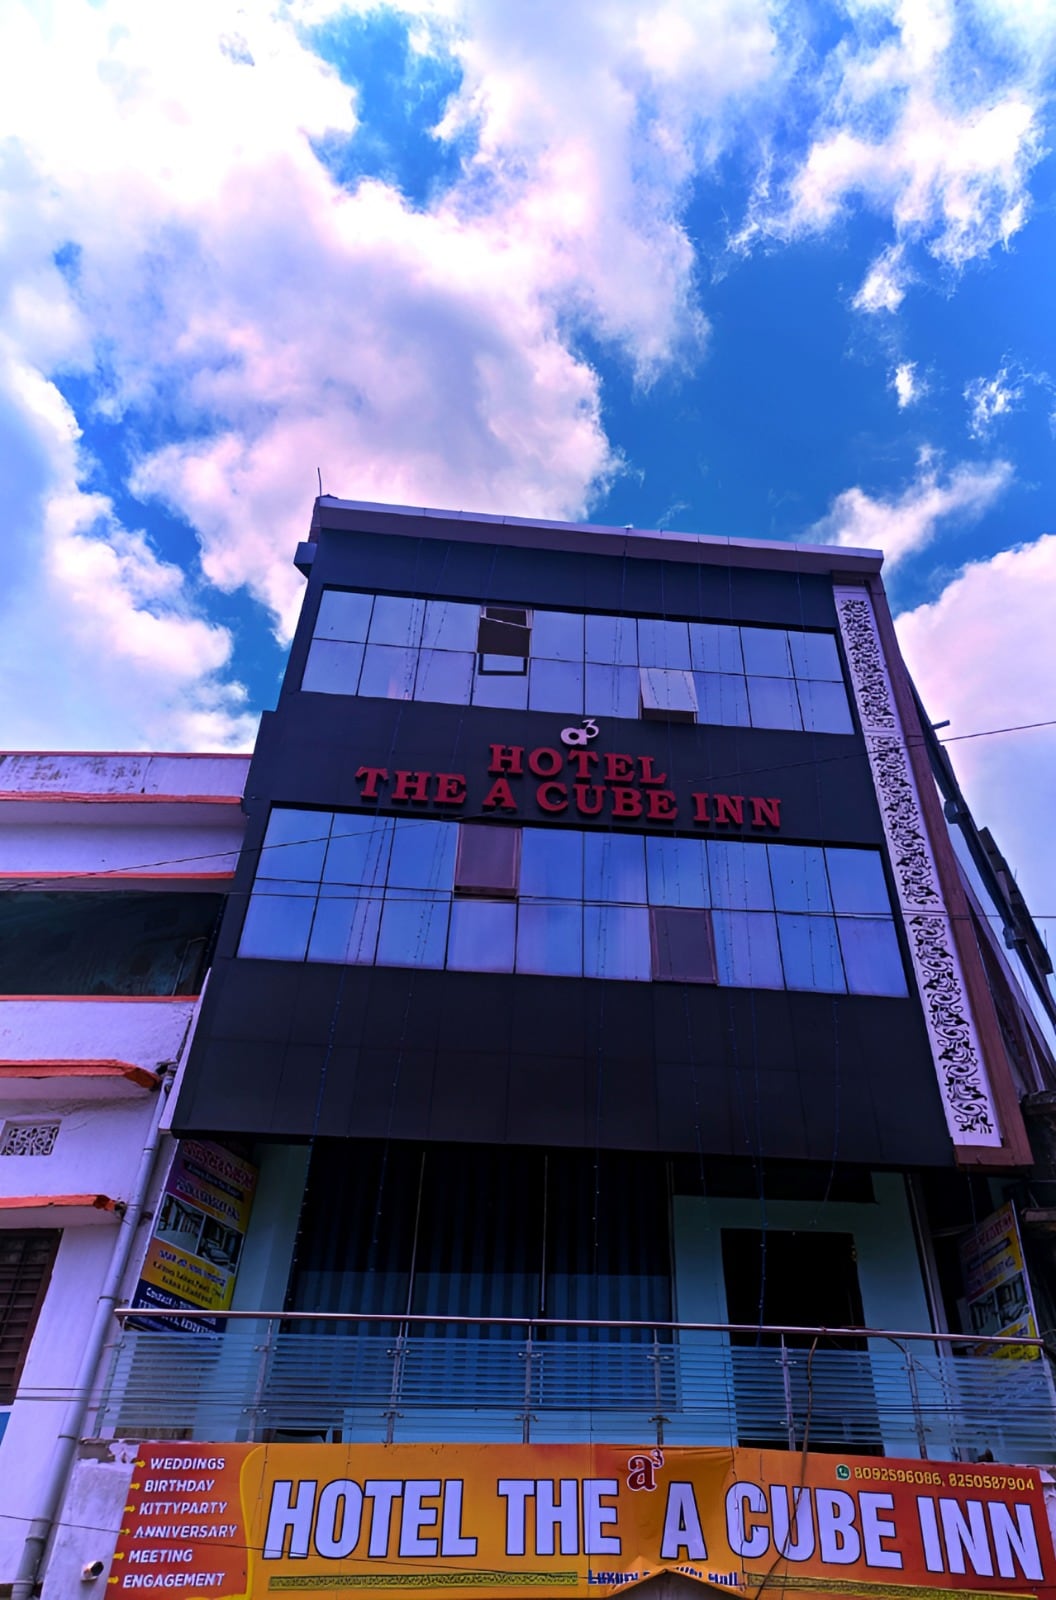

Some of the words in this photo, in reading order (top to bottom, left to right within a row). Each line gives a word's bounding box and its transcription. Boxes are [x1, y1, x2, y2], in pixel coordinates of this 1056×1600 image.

[488, 744, 667, 785] HOTEL
[355, 766, 467, 805] THE
[483, 778, 517, 811] A
[536, 782, 678, 820] CUBE
[691, 792, 781, 827] INN
[149, 1456, 225, 1471] WEDDINGS
[144, 1479, 215, 1493] BIRTHDAY
[139, 1501, 227, 1516] KITTYPARTY
[133, 1524, 238, 1540] ANNIVERSARY
[262, 1479, 478, 1559] HOTEL
[497, 1479, 621, 1556] THE
[660, 1481, 707, 1560] A
[725, 1481, 903, 1570] CUBE
[915, 1495, 1044, 1582] INN
[128, 1549, 193, 1564] MEETING
[122, 1572, 226, 1589] ENGAGEMENT
